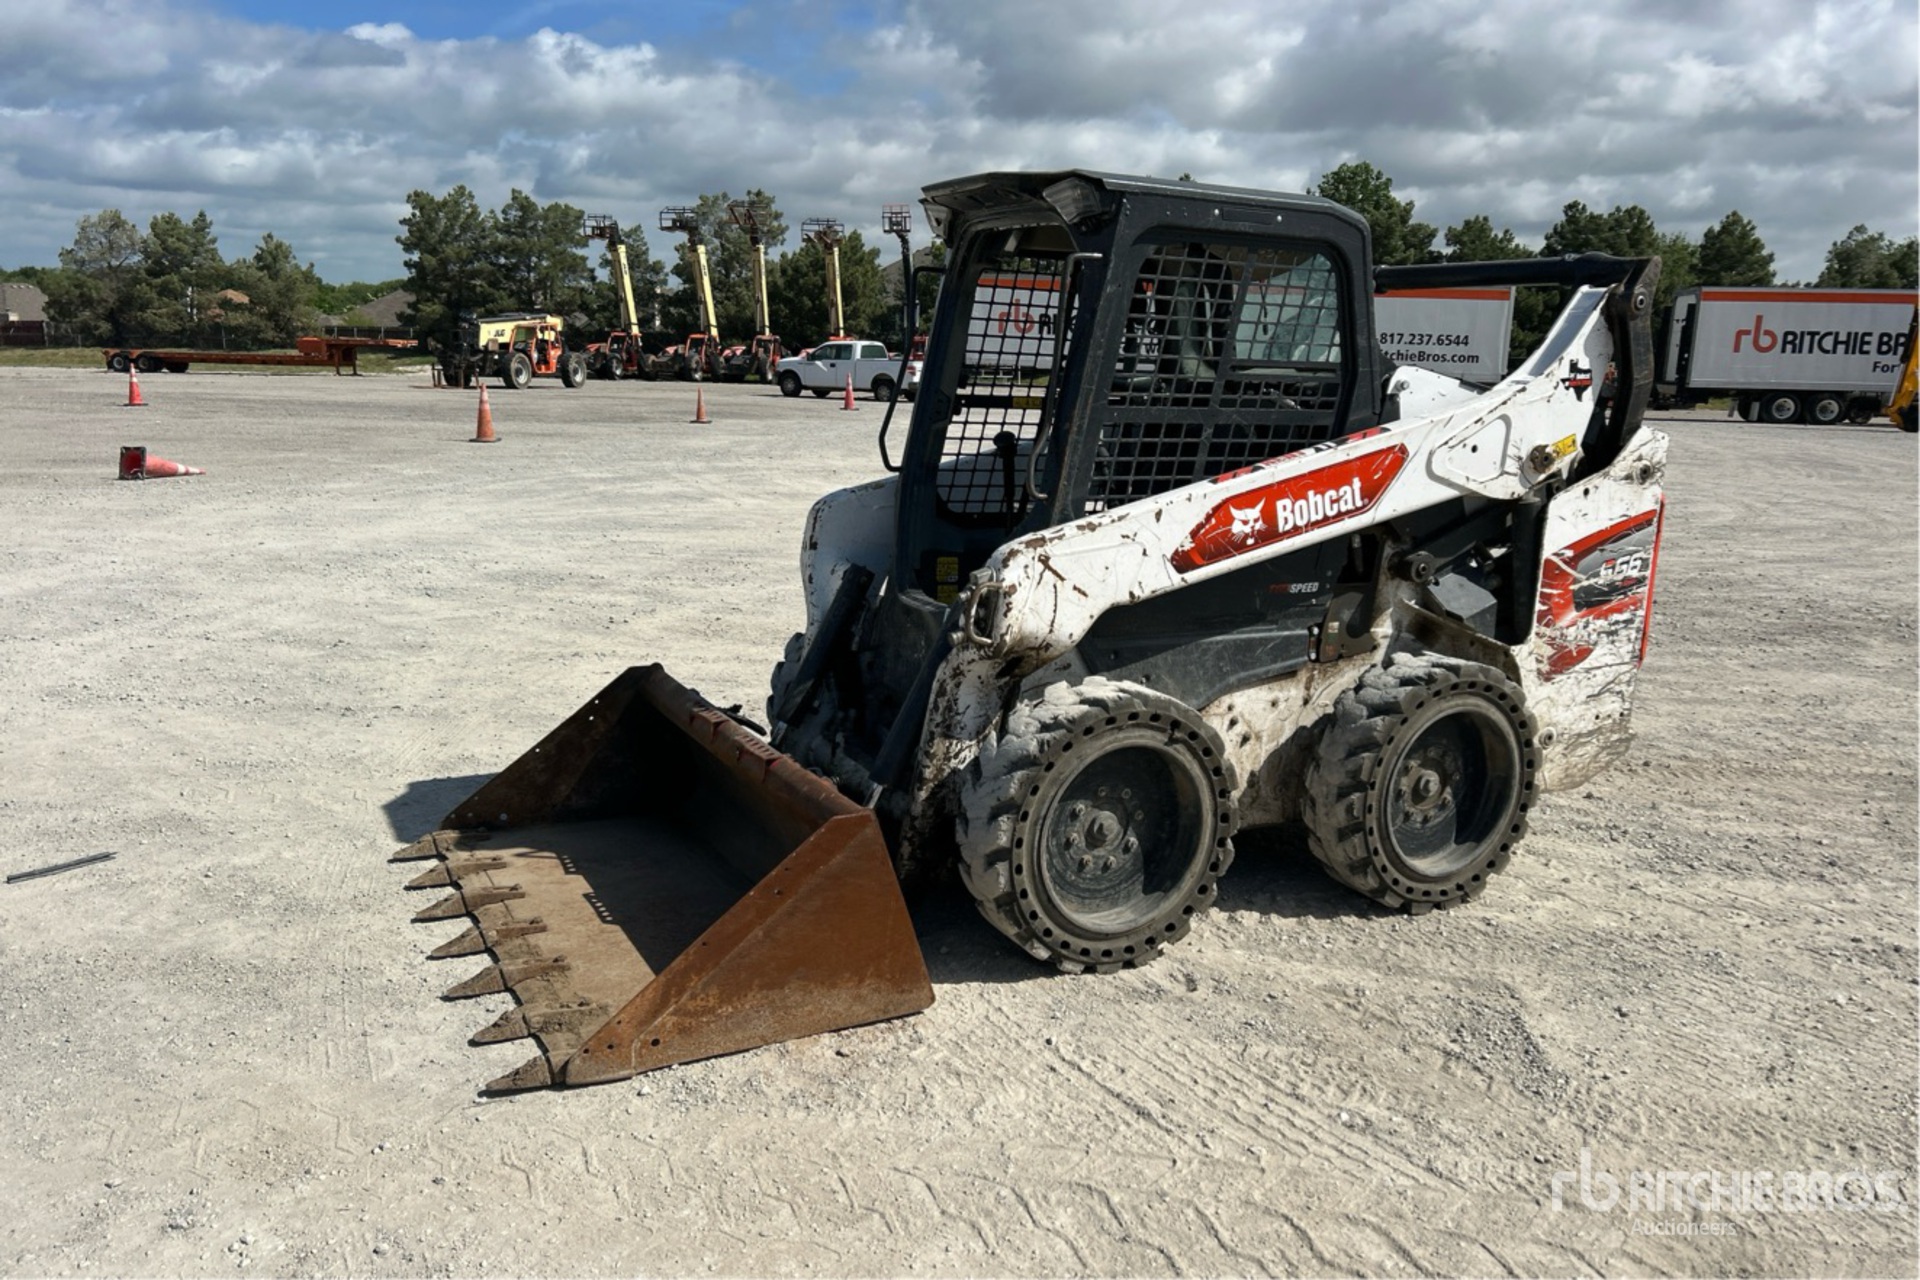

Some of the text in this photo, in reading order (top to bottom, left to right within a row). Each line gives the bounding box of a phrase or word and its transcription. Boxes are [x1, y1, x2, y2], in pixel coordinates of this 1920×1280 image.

[1380, 332, 1469, 346] 817.237.6544
[1732, 315, 1778, 353] rb
[1781, 331, 1873, 355] RITCHIE
[1380, 349, 1480, 363] tchieBros.com
[1872, 361, 1900, 373] For
[1276, 476, 1364, 533] Bobcat
